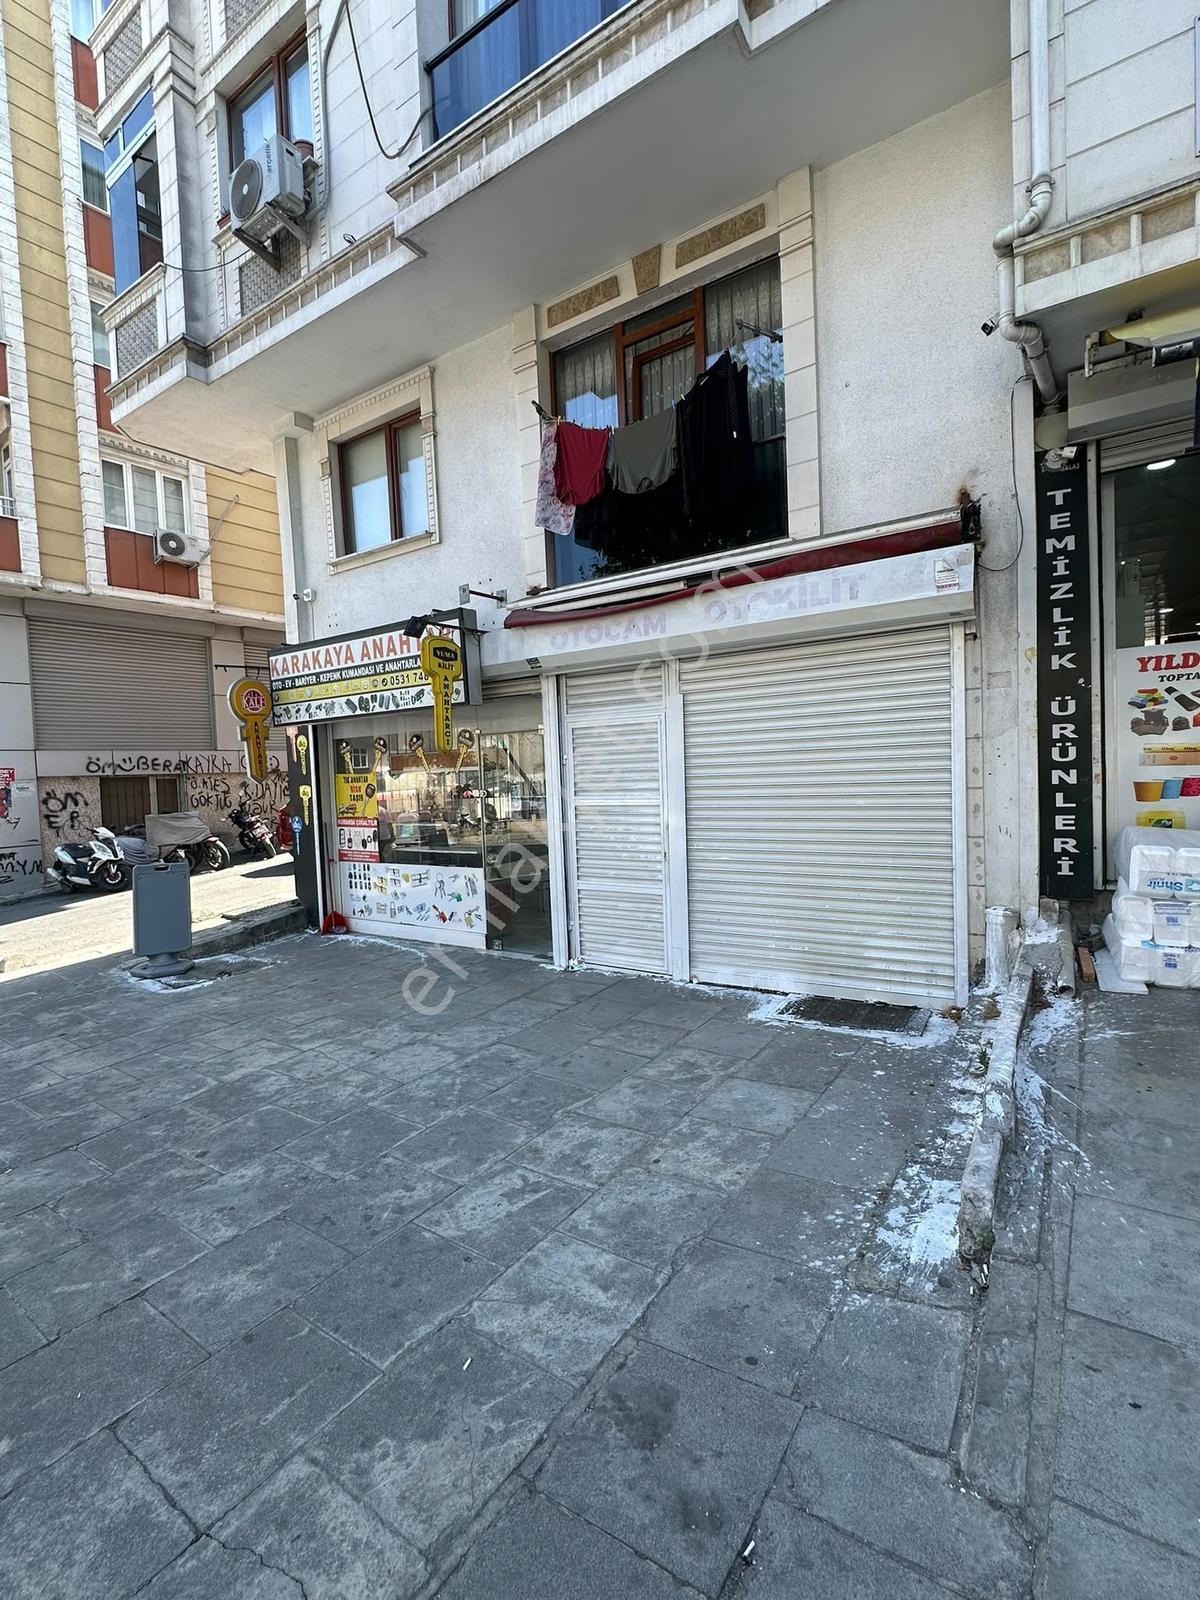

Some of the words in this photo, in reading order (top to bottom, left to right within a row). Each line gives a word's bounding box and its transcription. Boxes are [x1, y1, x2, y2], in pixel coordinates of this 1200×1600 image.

[1045, 487, 1077, 670] TEMİZLİK
[551, 612, 667, 650] OTOCAM
[271, 643, 355, 678] KARAKAYA
[272, 681, 282, 690] OTO
[285, 680, 292, 688] EV
[295, 675, 317, 687] BARİYER
[320, 671, 341, 683] KEPENK
[342, 664, 375, 679] KUMANDASI
[375, 664, 384, 673] VE
[384, 657, 422, 671] ANAHTARLA
[390, 674, 410, 686] 0531
[443, 674, 451, 746] ANAHTARCI
[1050, 696, 1080, 876] ÜRÜNLERİ
